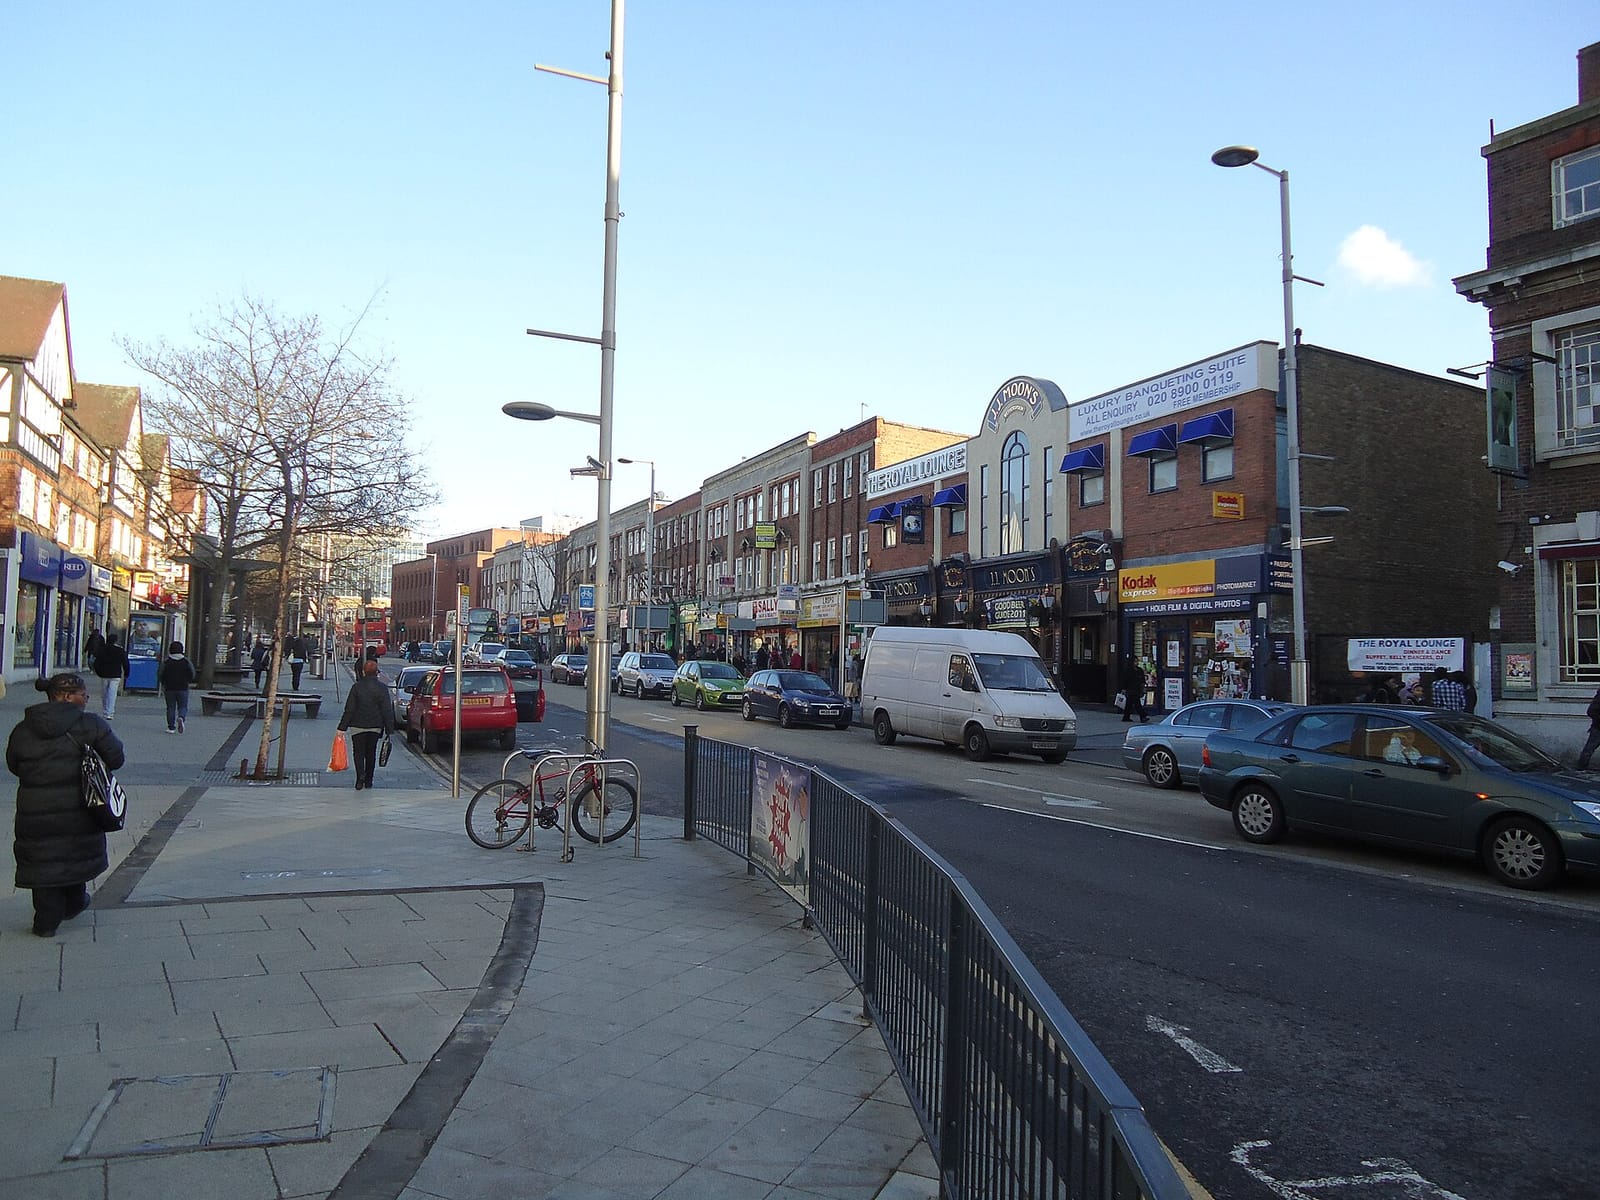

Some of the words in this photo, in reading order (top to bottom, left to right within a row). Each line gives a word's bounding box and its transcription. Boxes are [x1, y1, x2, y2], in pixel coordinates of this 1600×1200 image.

[1077, 395, 1121, 416] LUXURY
[1125, 368, 1204, 400] BANQUETING
[1208, 354, 1247, 374] SUITE
[1002, 381, 1039, 405] MOON'S
[1086, 414, 1100, 425] ALL
[1102, 401, 1138, 421] ENQUIRY
[1147, 392, 1167, 407] 020
[1171, 381, 1199, 400] 8900
[1203, 371, 1234, 388] 0119
[1173, 396, 1192, 409] FREE
[1193, 382, 1241, 403] MEMBERSHIP
[867, 473, 886, 494] THE
[886, 463, 919, 489] ROYAL
[920, 448, 966, 478] LOUNGE
[63, 563, 84, 571] REED
[1273, 560, 1293, 568] PASSPO
[1122, 574, 1157, 590] Kodak
[1216, 580, 1257, 590] PHOTOMARKET
[1122, 587, 1158, 599] express
[757, 598, 779, 612] SALLY
[994, 601, 1011, 611] GOOD
[1011, 600, 1025, 609] BEER
[1149, 604, 1167, 612] HOUR
[1168, 603, 1182, 611] FILM
[1189, 601, 1213, 610] DIGITAL
[1214, 600, 1241, 608] PHOTOS
[994, 609, 1010, 620] GUIDE
[1010, 609, 1026, 618] 2011
[1357, 640, 1376, 648] THE
[1378, 639, 1412, 648] ROYAL
[1415, 639, 1456, 648] LOUNGE
